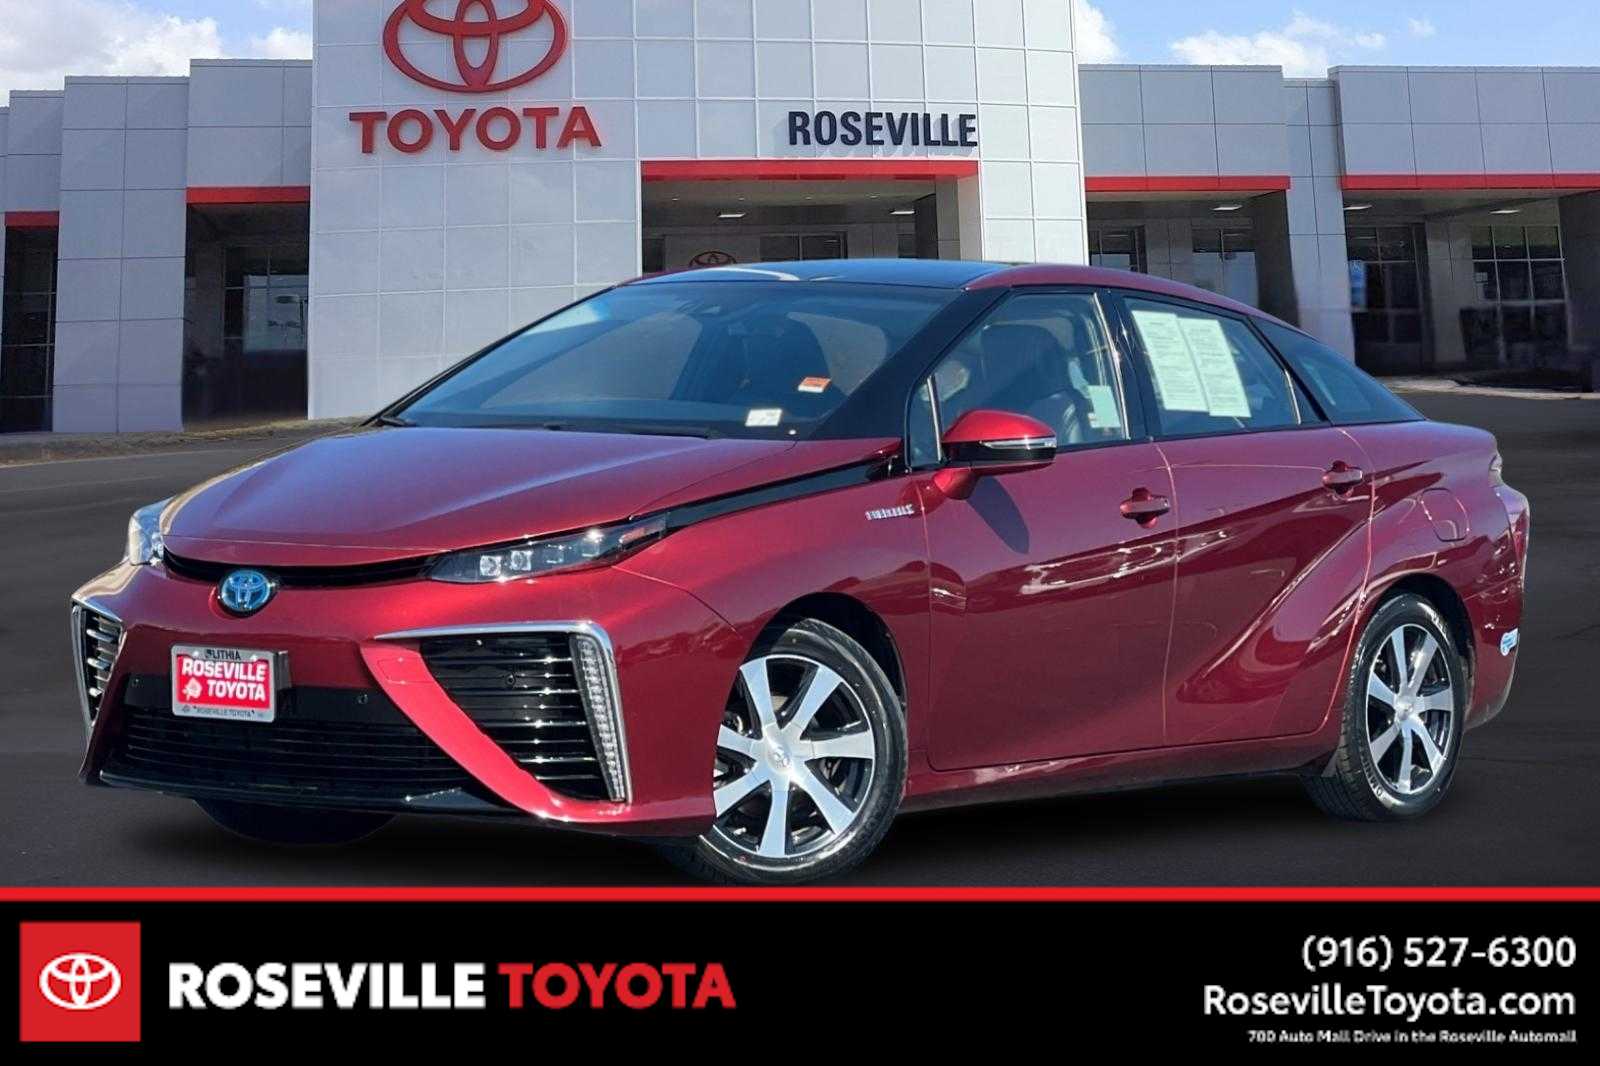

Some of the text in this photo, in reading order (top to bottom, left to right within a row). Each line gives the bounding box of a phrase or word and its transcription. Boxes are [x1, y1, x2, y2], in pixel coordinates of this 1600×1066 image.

[349, 106, 602, 154] TOYOTA
[788, 110, 978, 147] ROSEVILLE
[211, 649, 241, 660] LITHIA
[181, 657, 268, 682] ROSEVILLE
[206, 679, 266, 702] TOYOTA
